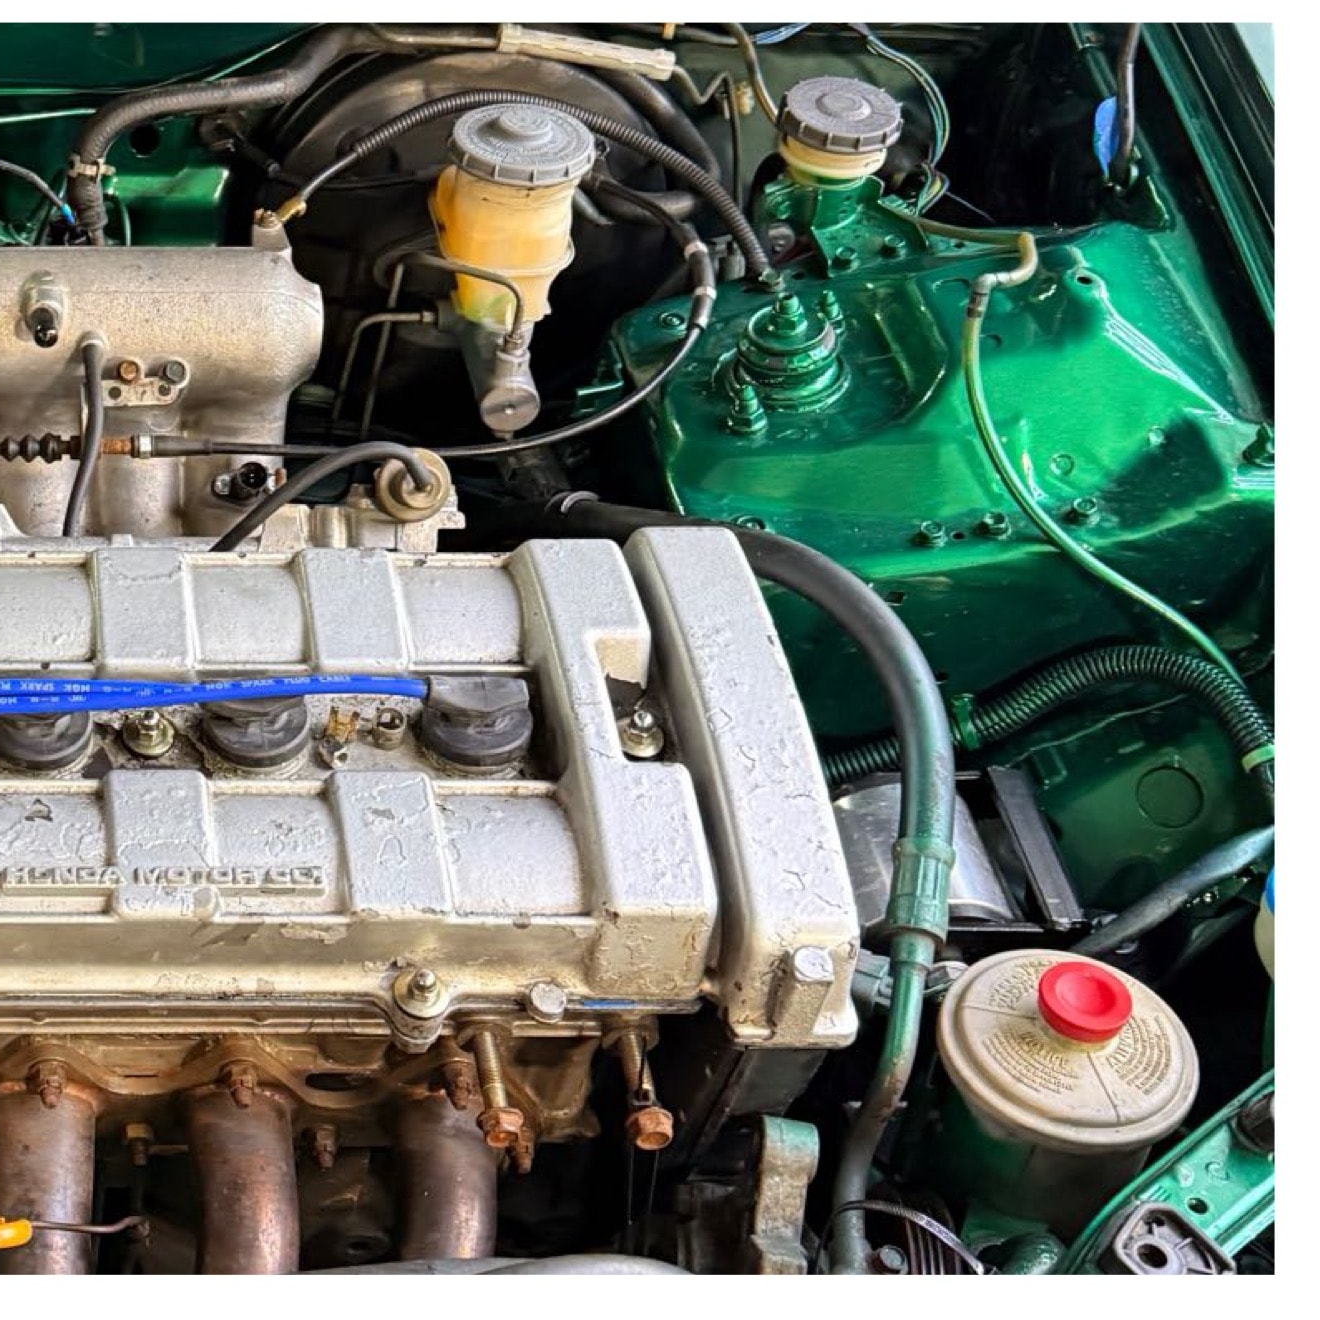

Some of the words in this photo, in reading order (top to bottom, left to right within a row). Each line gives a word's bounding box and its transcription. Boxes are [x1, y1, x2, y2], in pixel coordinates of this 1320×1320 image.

[20, 681, 54, 692] SPARK
[6, 866, 124, 885] HONDA
[134, 866, 257, 885] MOTOR
